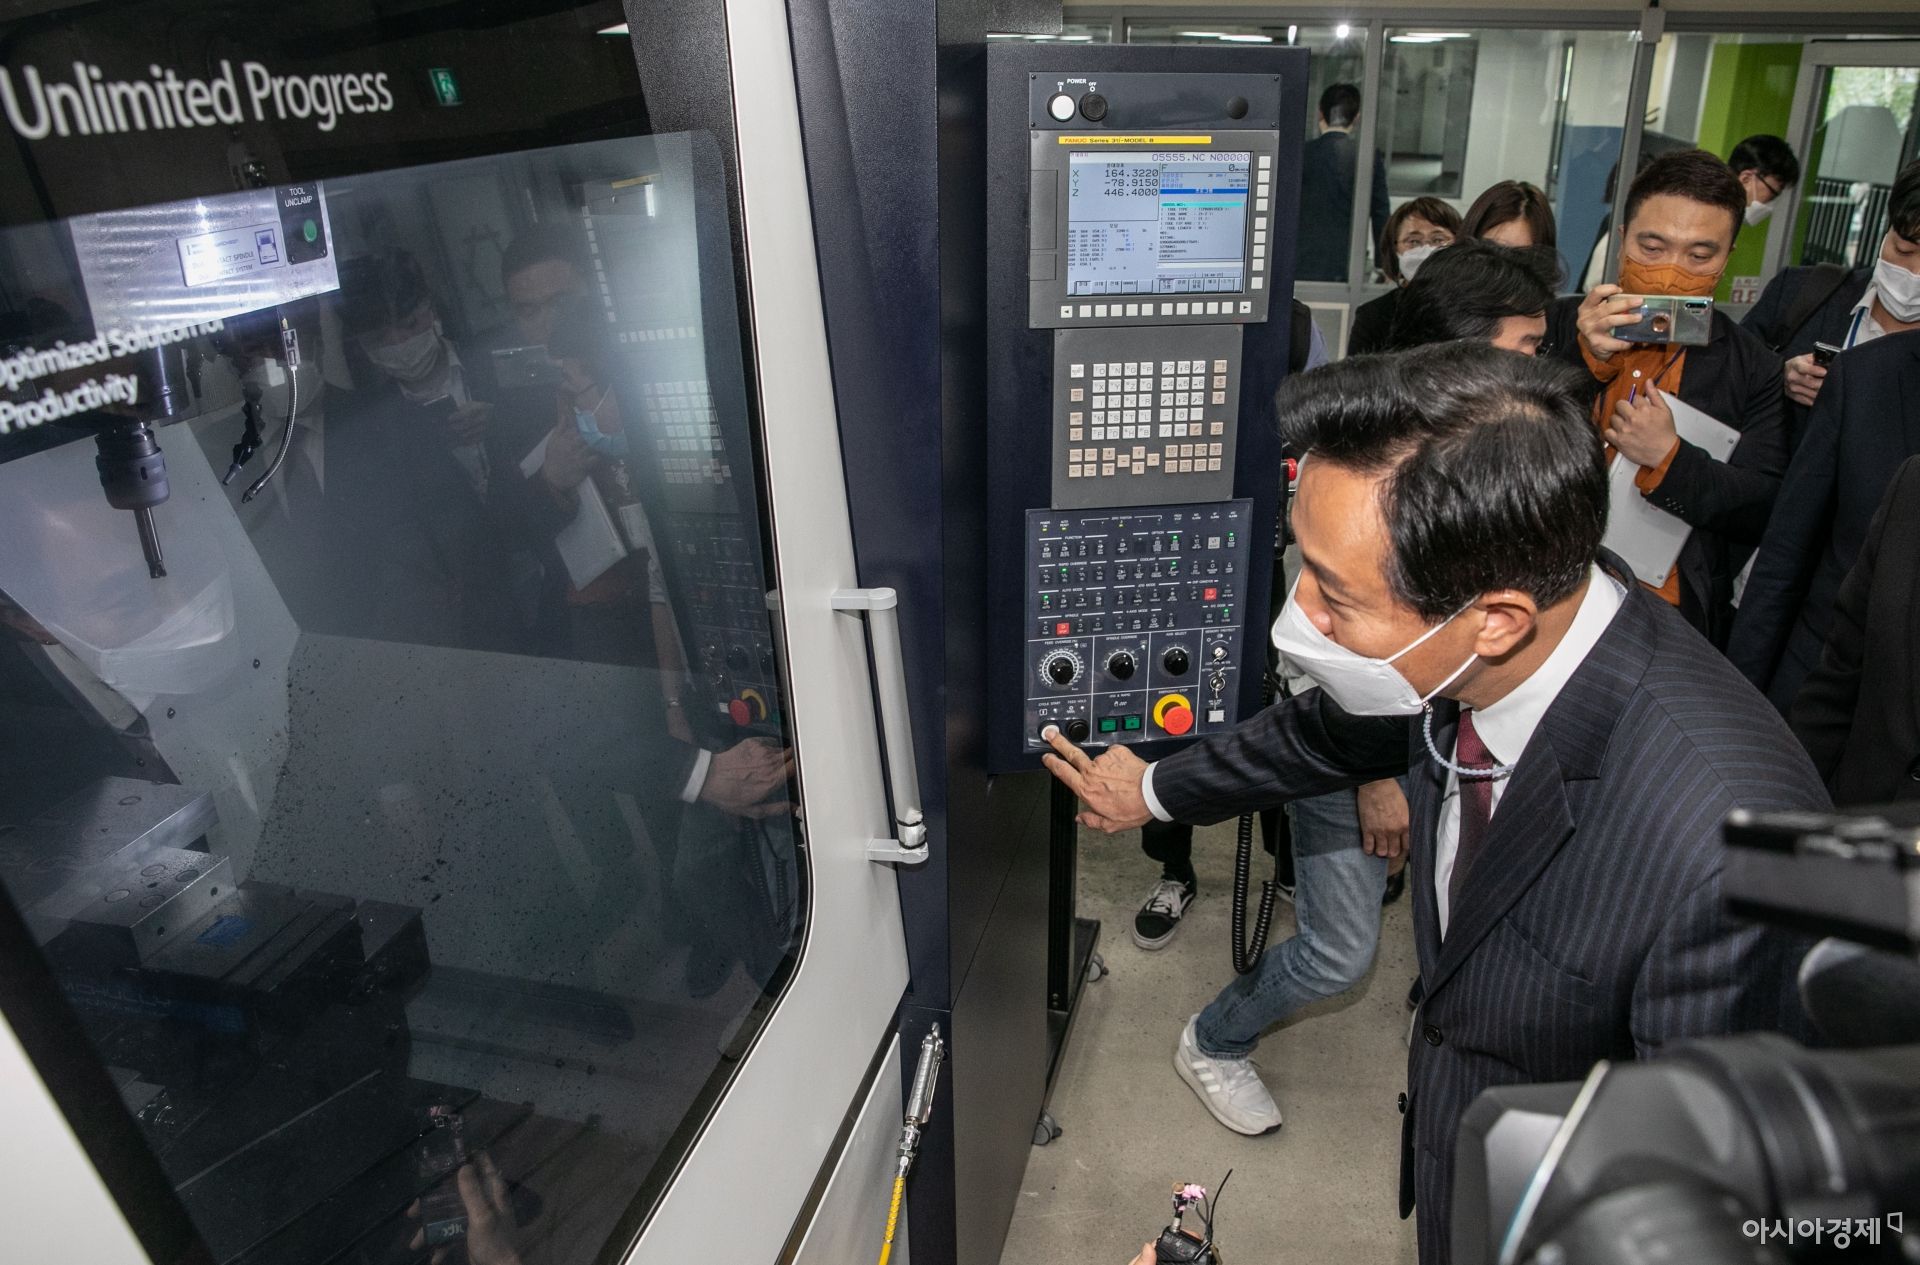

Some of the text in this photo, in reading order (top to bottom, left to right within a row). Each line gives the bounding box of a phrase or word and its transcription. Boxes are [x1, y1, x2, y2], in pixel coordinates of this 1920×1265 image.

[0, 59, 394, 140] Unlimited Progress
[1210, 153, 1250, 162] N00000
[1072, 169, 1159, 178] X 164.3220
[1072, 179, 1079, 187] Y
[1104, 179, 1159, 187] -78.9150
[289, 187, 306, 196] TOOL
[1072, 188, 1158, 197] Z 446.4000
[284, 195, 313, 208] UNCLAMP
[0, 374, 138, 434] Productivity
